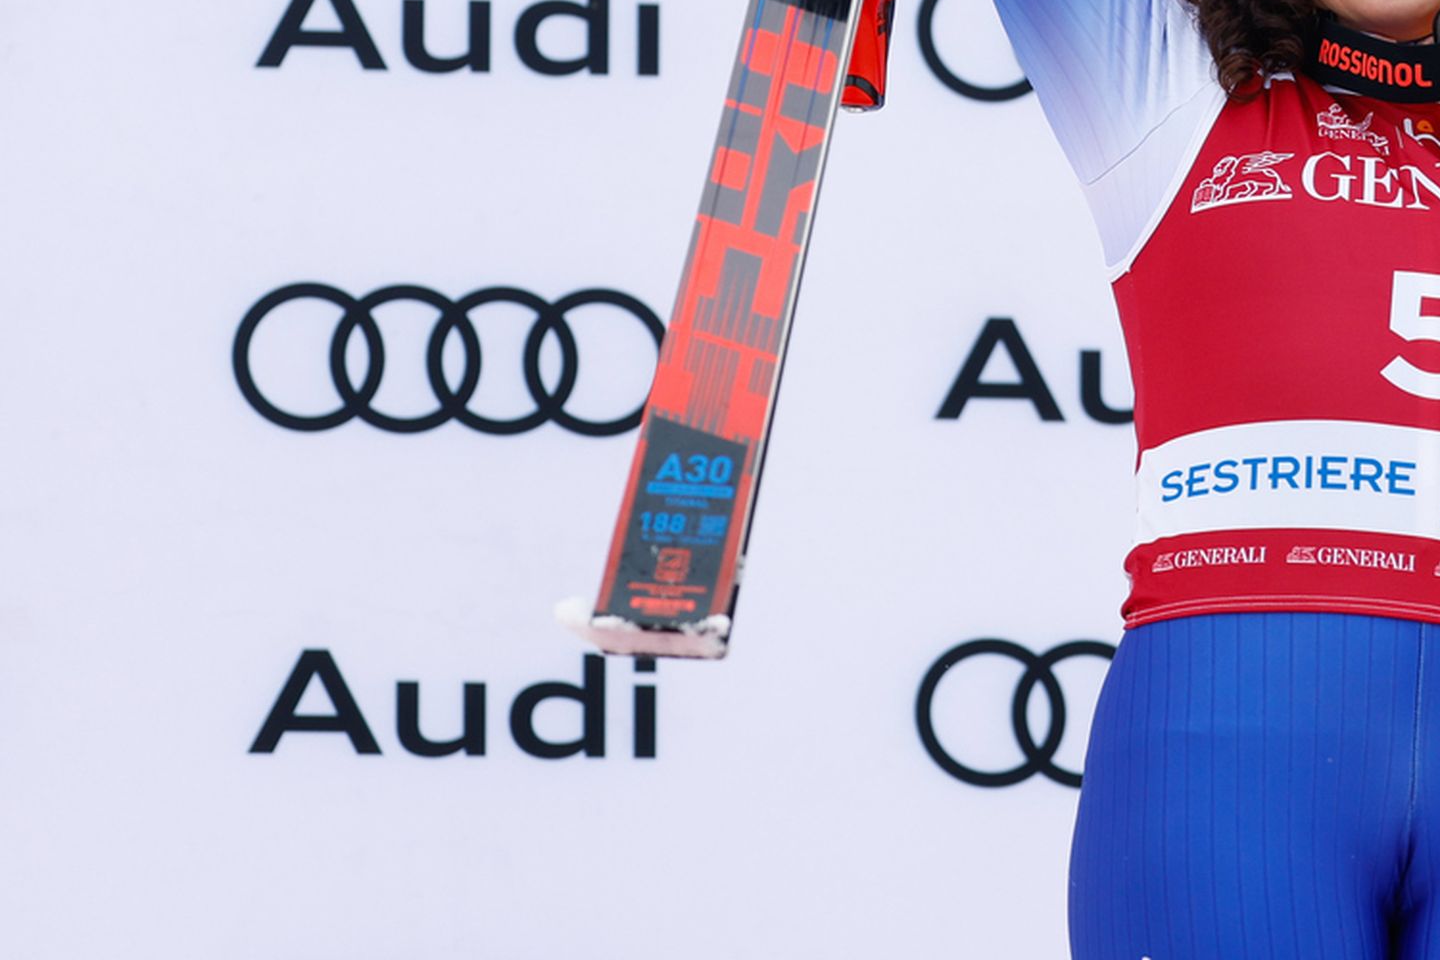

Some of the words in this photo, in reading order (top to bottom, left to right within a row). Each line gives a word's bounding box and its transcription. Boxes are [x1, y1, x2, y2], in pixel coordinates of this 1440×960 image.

[1318, 38, 1433, 88] ROSSIGNOL
[655, 452, 734, 484] A30
[1161, 454, 1417, 503] SESTRIERE
[640, 510, 687, 534] 188
[1174, 546, 1267, 568] GENERALI
[1317, 547, 1416, 572] GENERALI
[248, 648, 658, 761] Audi
